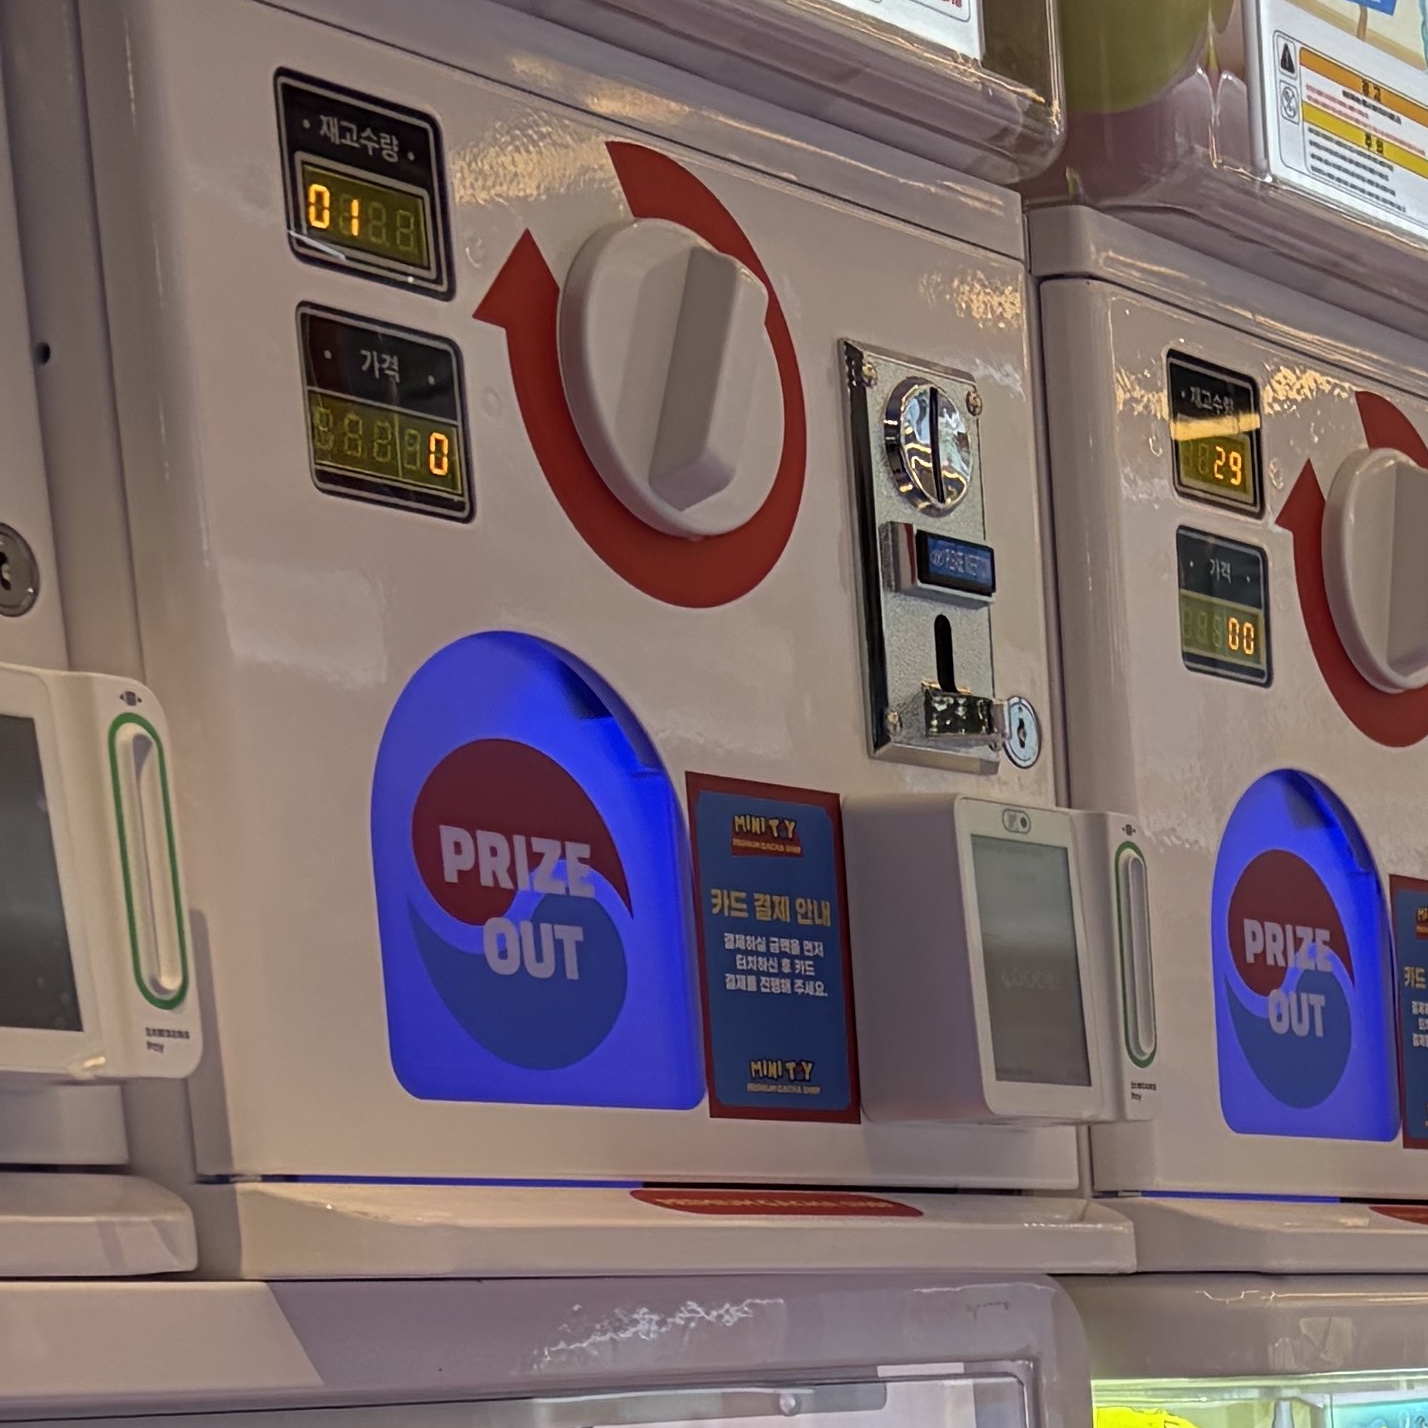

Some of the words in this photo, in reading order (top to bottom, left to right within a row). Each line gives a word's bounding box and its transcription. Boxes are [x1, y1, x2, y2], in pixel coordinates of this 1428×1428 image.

[319, 113, 401, 165] 재고수량
[360, 348, 400, 383] 가격
[439, 825, 594, 898] PRIZE
[710, 888, 749, 918] 카드
[753, 892, 790, 923] 결제
[795, 897, 832, 928] 안내
[483, 916, 583, 981] OUT
[1243, 917, 1333, 973] PRIZE
[1267, 987, 1327, 1040] OUT
